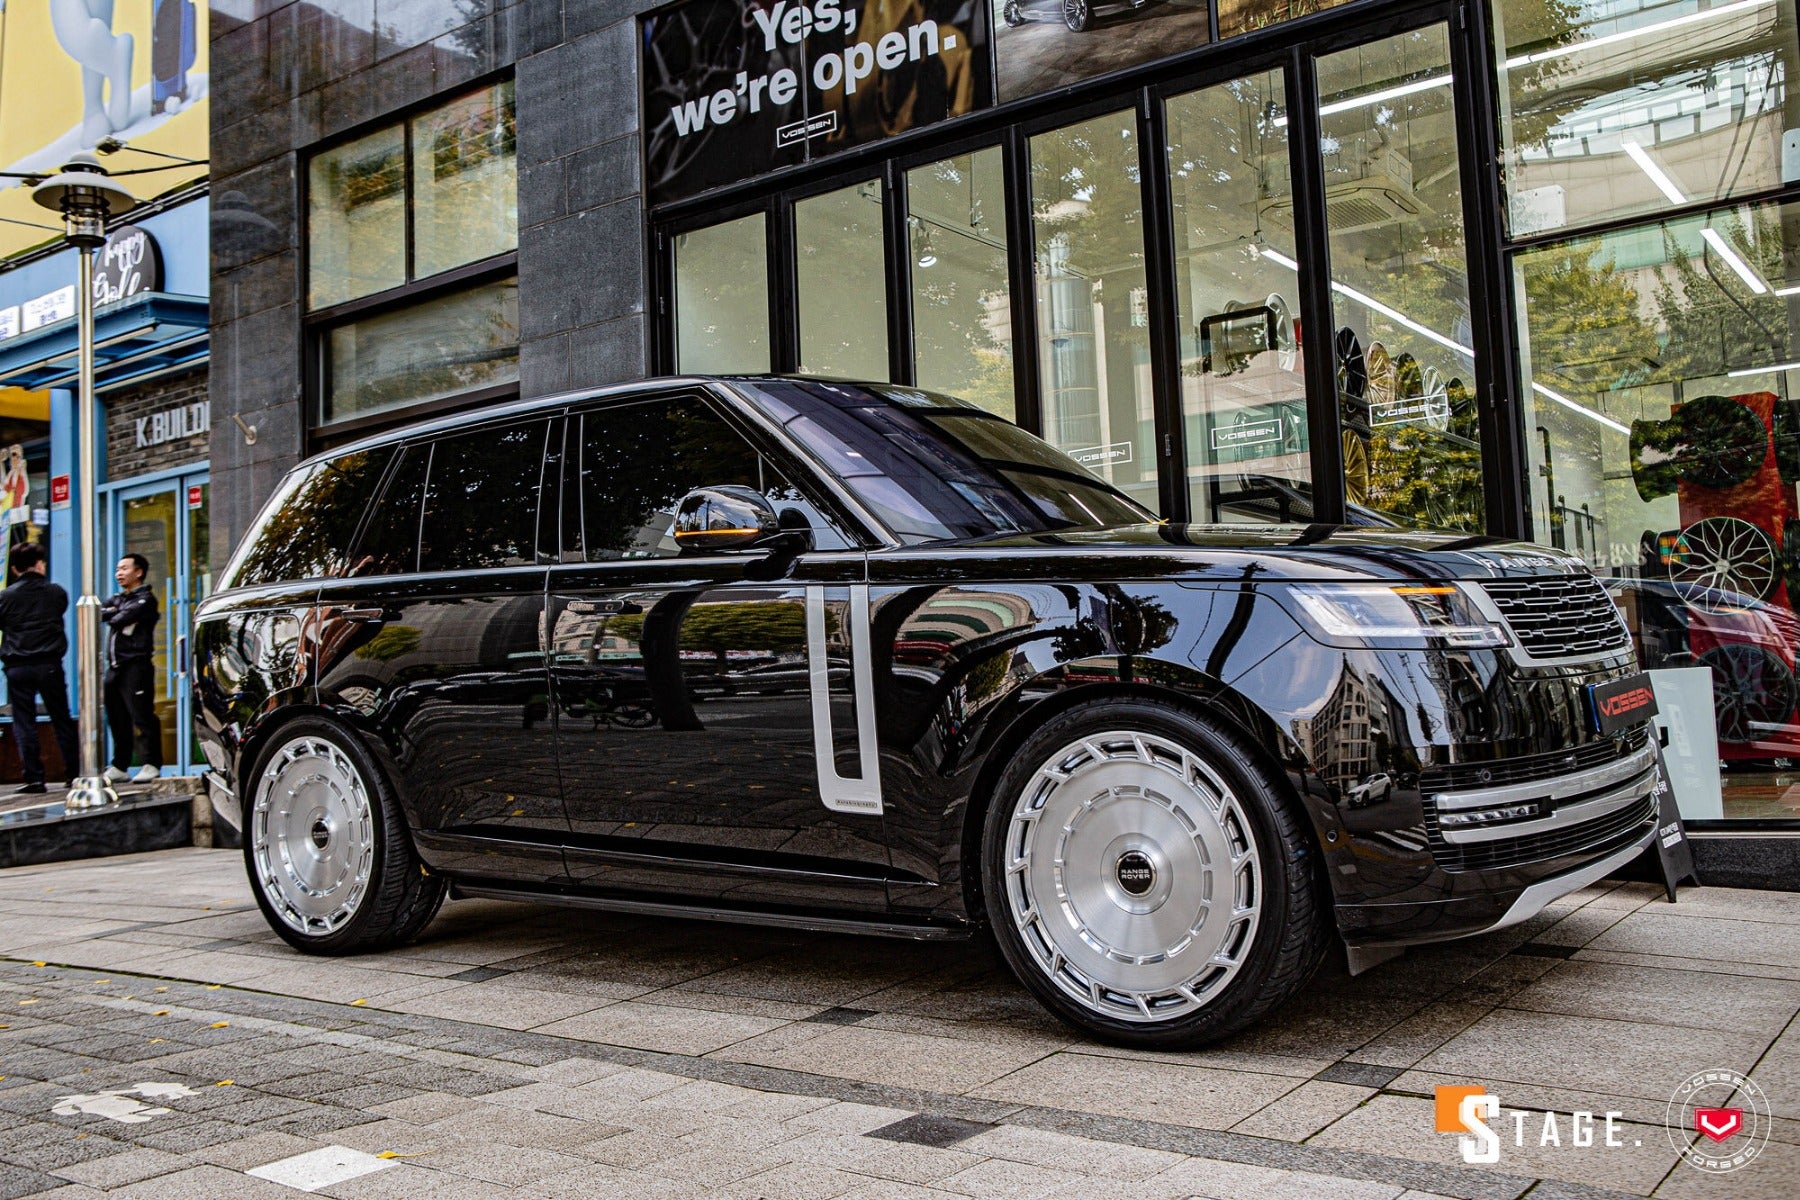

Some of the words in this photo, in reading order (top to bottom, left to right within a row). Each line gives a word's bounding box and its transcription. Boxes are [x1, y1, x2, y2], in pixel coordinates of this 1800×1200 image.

[753, 0, 856, 51] Yes,
[671, 68, 797, 136] we're
[813, 19, 957, 95] open.
[782, 119, 831, 138] VOSSEN
[1377, 402, 1440, 417] VOSSEN
[1218, 427, 1275, 440] VOSSEN
[1074, 449, 1125, 462] VOSSEN
[1478, 557, 1554, 569] RANGE
[1600, 685, 1654, 717] VOSSEN
